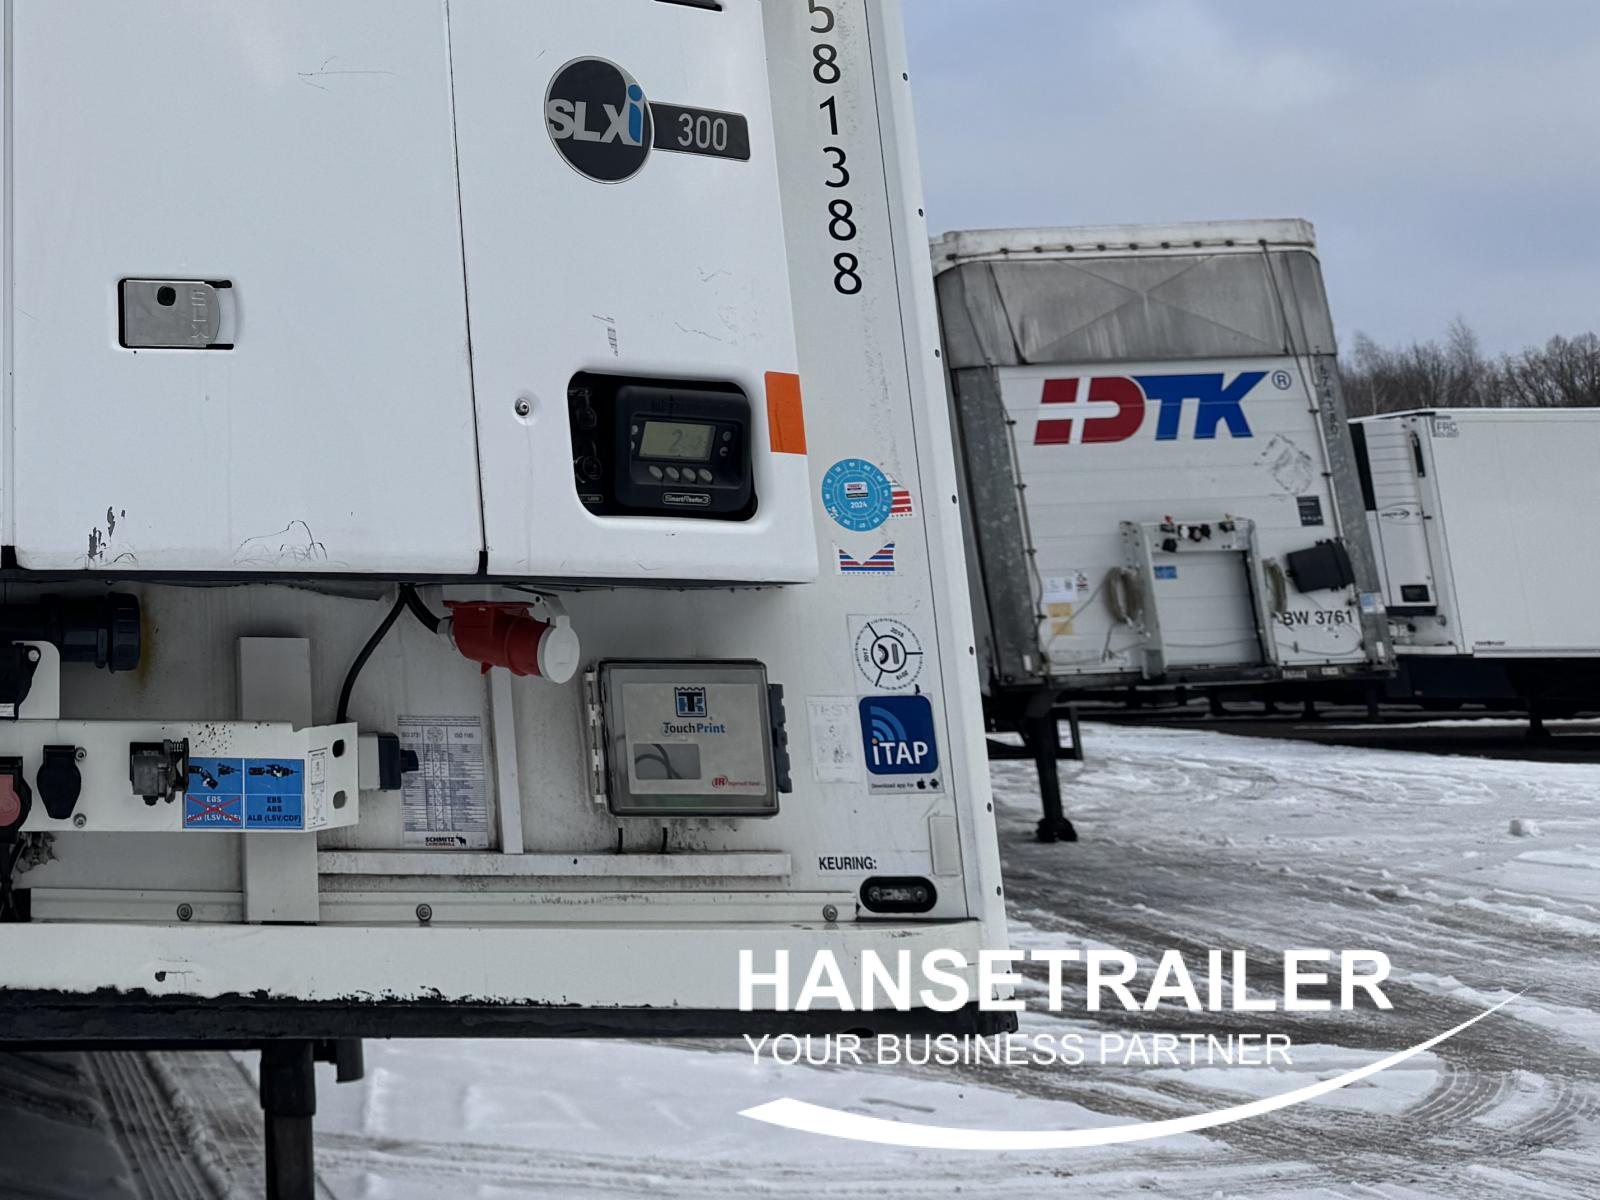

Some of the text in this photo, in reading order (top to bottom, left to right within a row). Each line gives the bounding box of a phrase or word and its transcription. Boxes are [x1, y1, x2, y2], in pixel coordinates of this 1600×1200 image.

[549, 84, 728, 151] SLXi 300
[850, 501, 868, 509] 2024
[1315, 610, 1353, 625] 3761
[871, 737, 929, 766] iTAP
[247, 814, 263, 822] ALB
[818, 856, 878, 870] KEURING:
